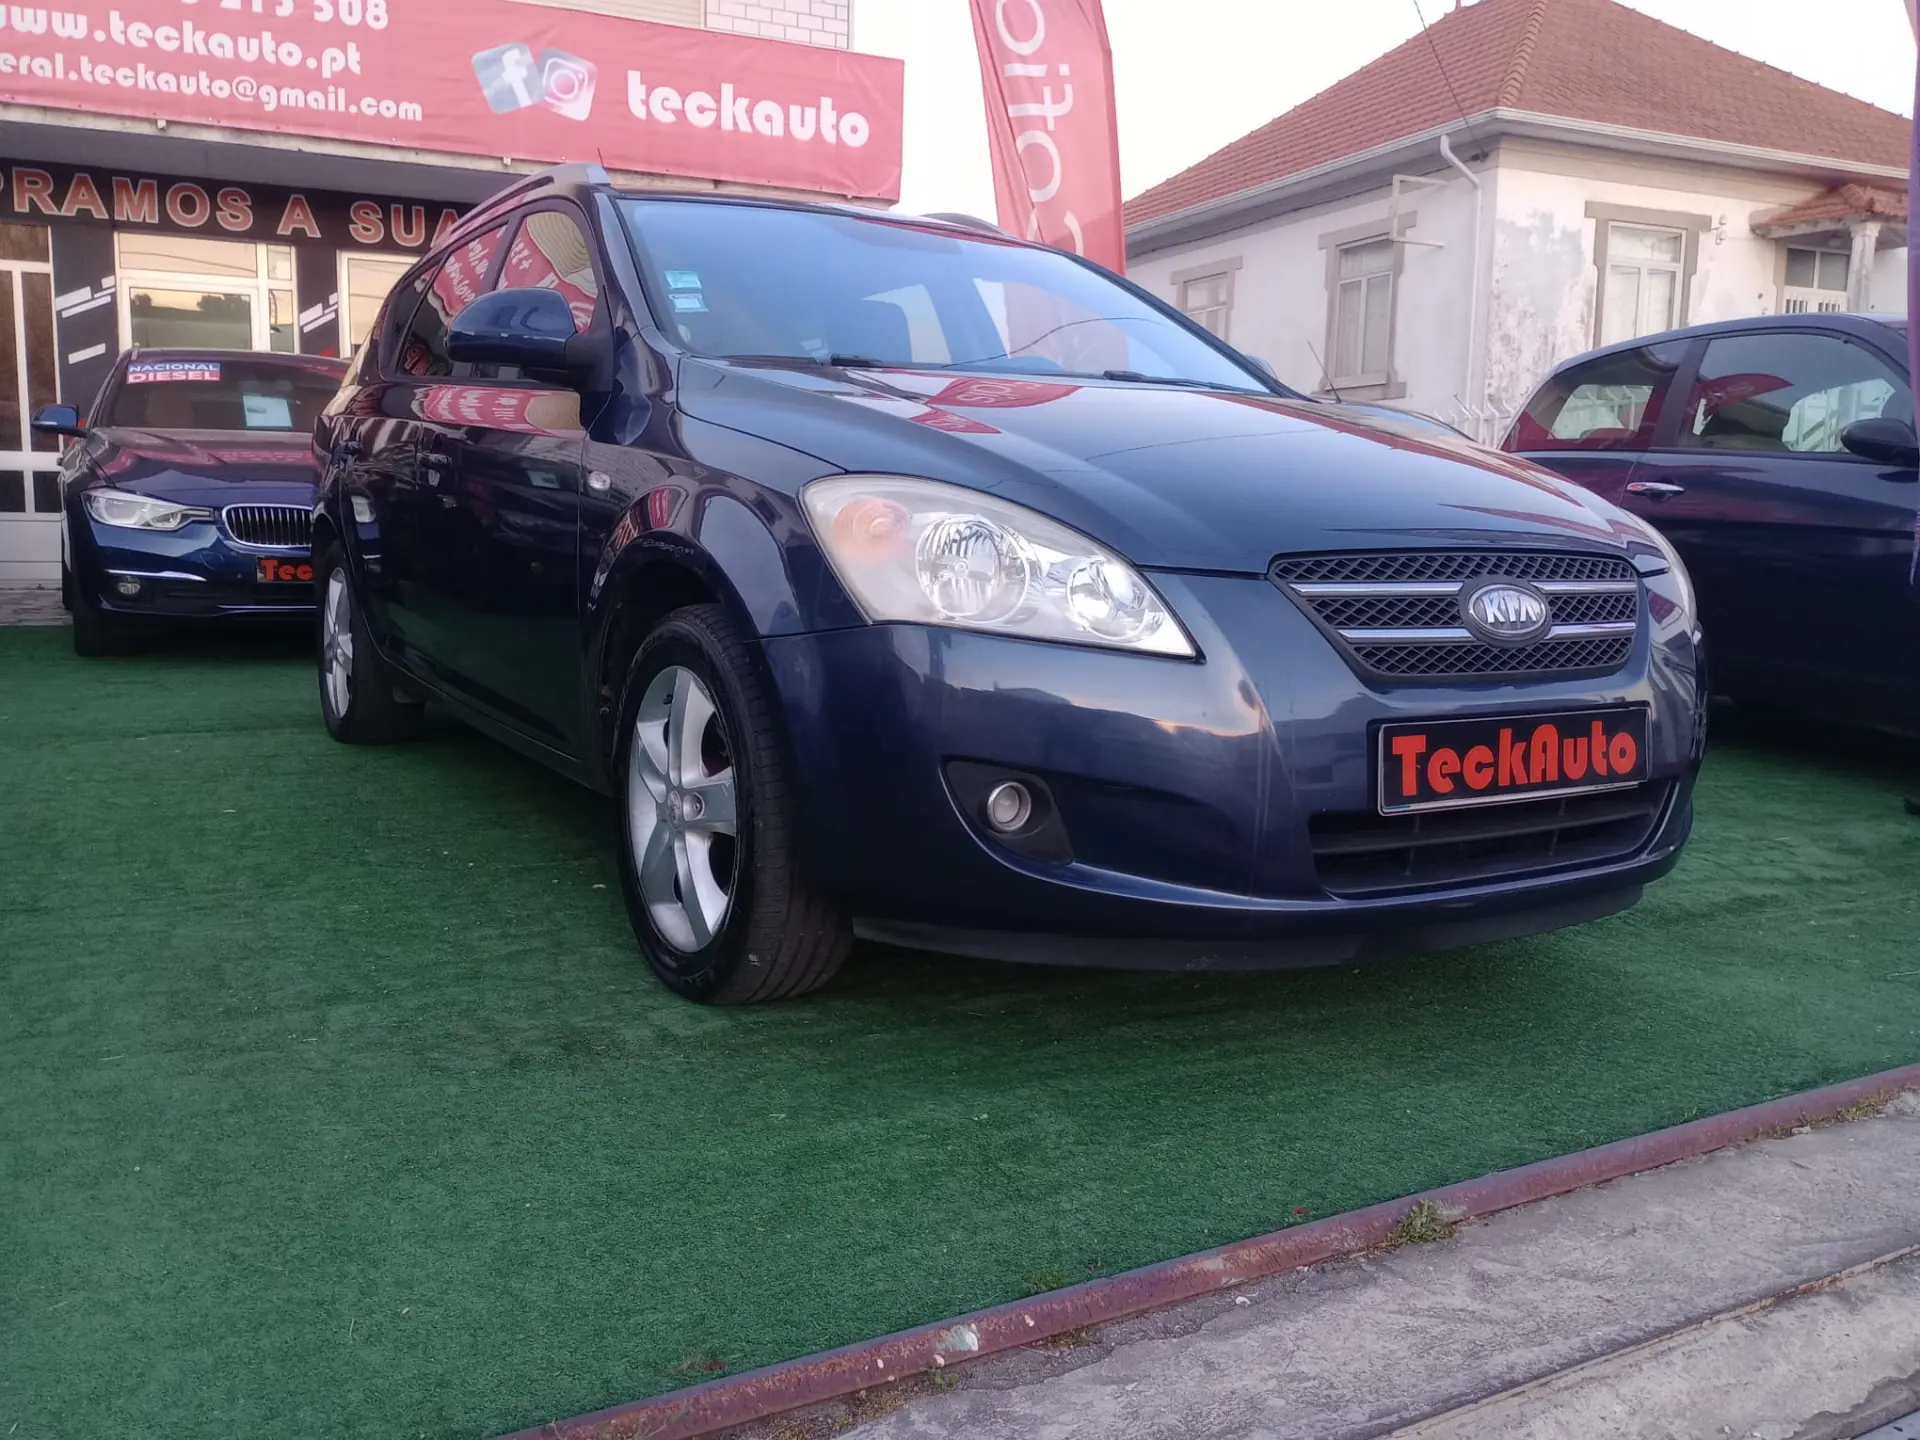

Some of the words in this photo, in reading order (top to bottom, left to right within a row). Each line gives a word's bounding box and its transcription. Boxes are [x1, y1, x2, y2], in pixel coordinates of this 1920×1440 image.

[0, 4, 361, 78] ww.teckauto.pt
[627, 70, 870, 148] teckauto
[0, 166, 254, 231] RAMOS
[276, 194, 321, 238] A
[127, 370, 220, 384] DIESEL
[129, 362, 218, 373] NACIONAL
[1481, 590, 1538, 624] KIA
[1392, 719, 1637, 798] TeckAuto
